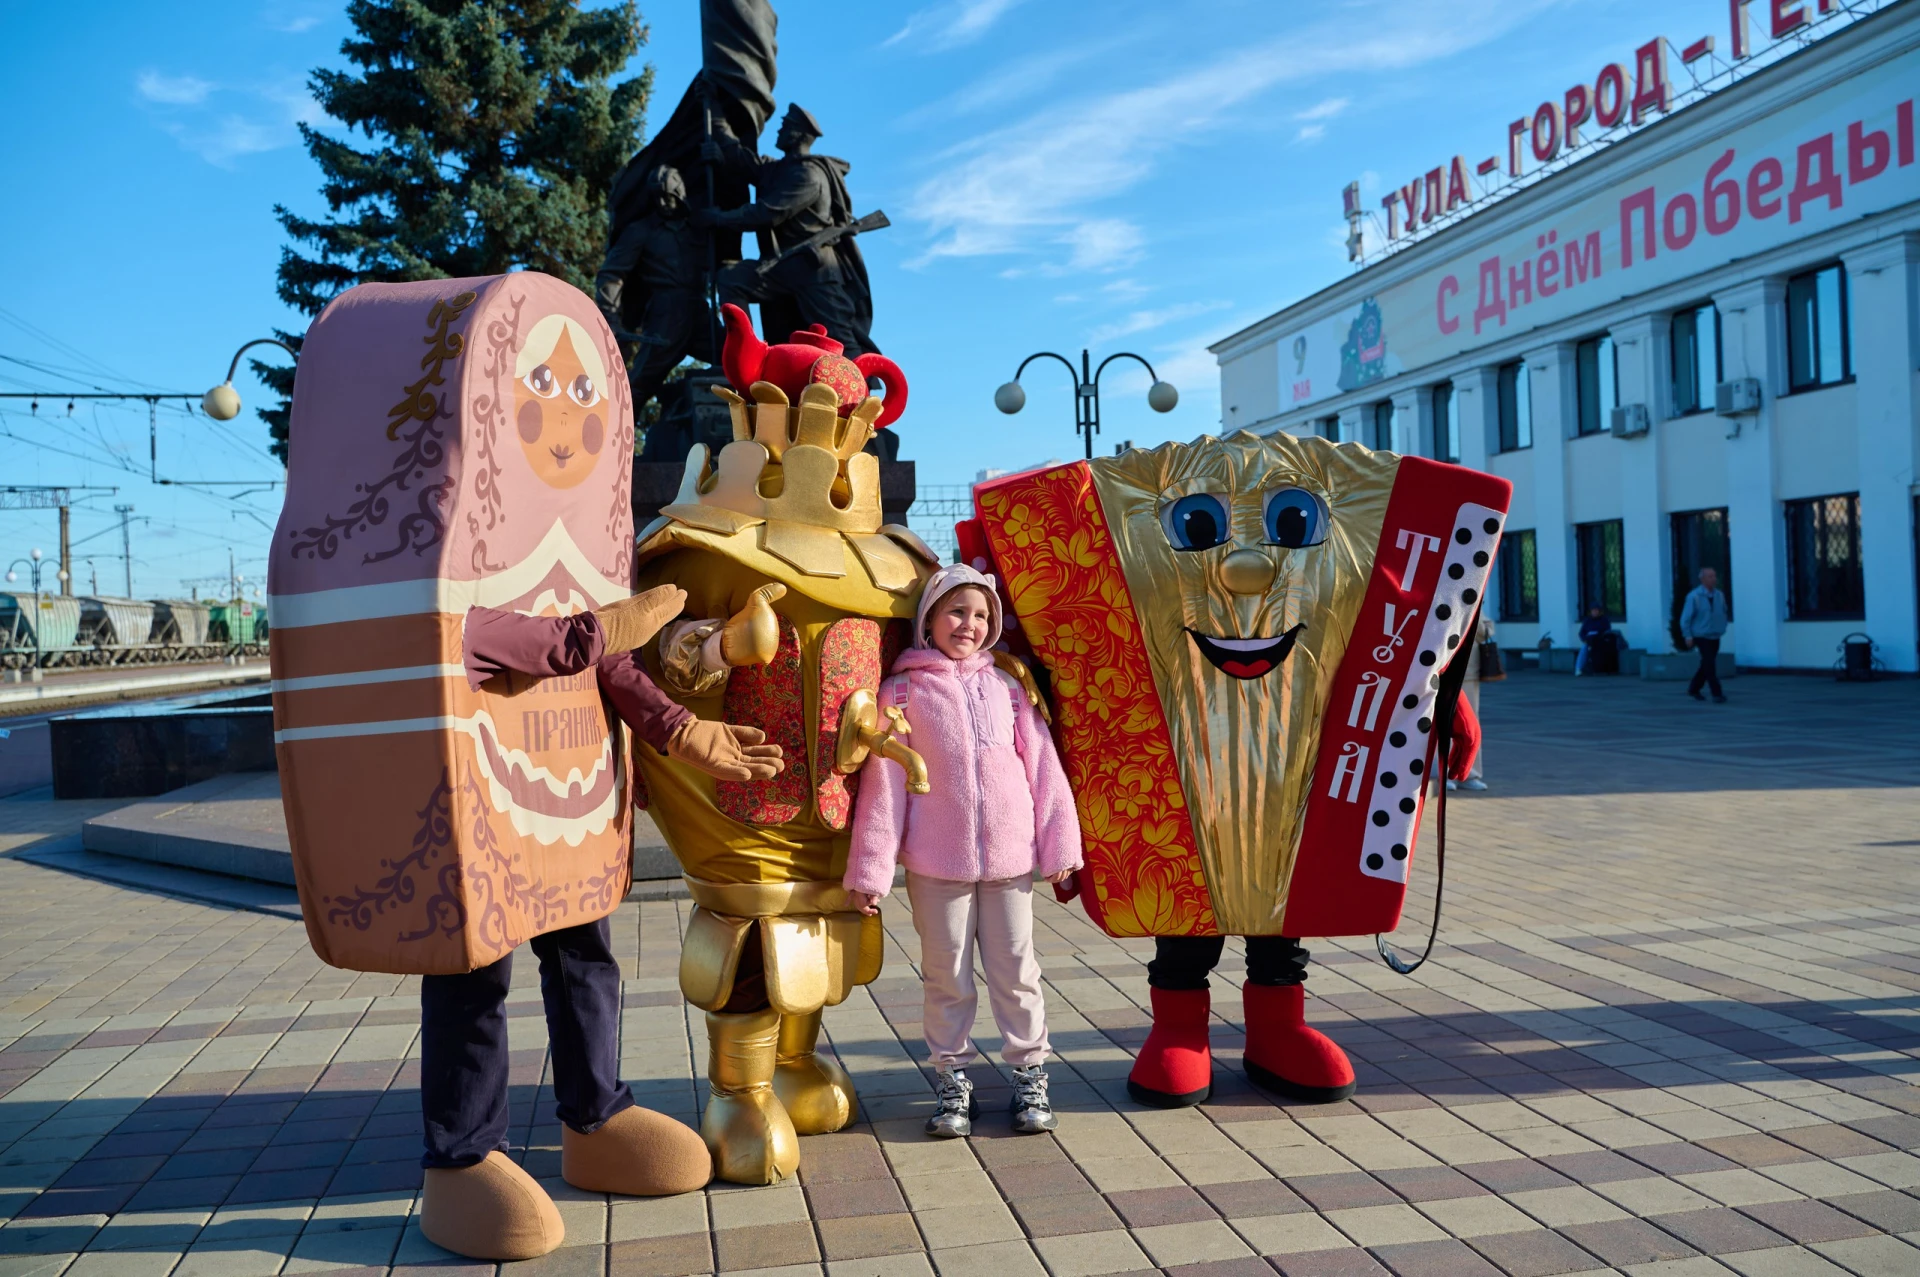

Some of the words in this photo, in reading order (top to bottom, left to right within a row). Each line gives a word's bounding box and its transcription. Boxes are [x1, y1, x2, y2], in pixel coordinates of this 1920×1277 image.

[1381, 154, 1472, 240] ТУЛА
[1508, 36, 1672, 178] ГОРОД
[1436, 275, 1460, 336] С
[1474, 230, 1602, 334] Днём
[1620, 98, 1916, 270] Победы
[1293, 335, 1307, 376] 9
[522, 705, 602, 754] ПРЯНИК
